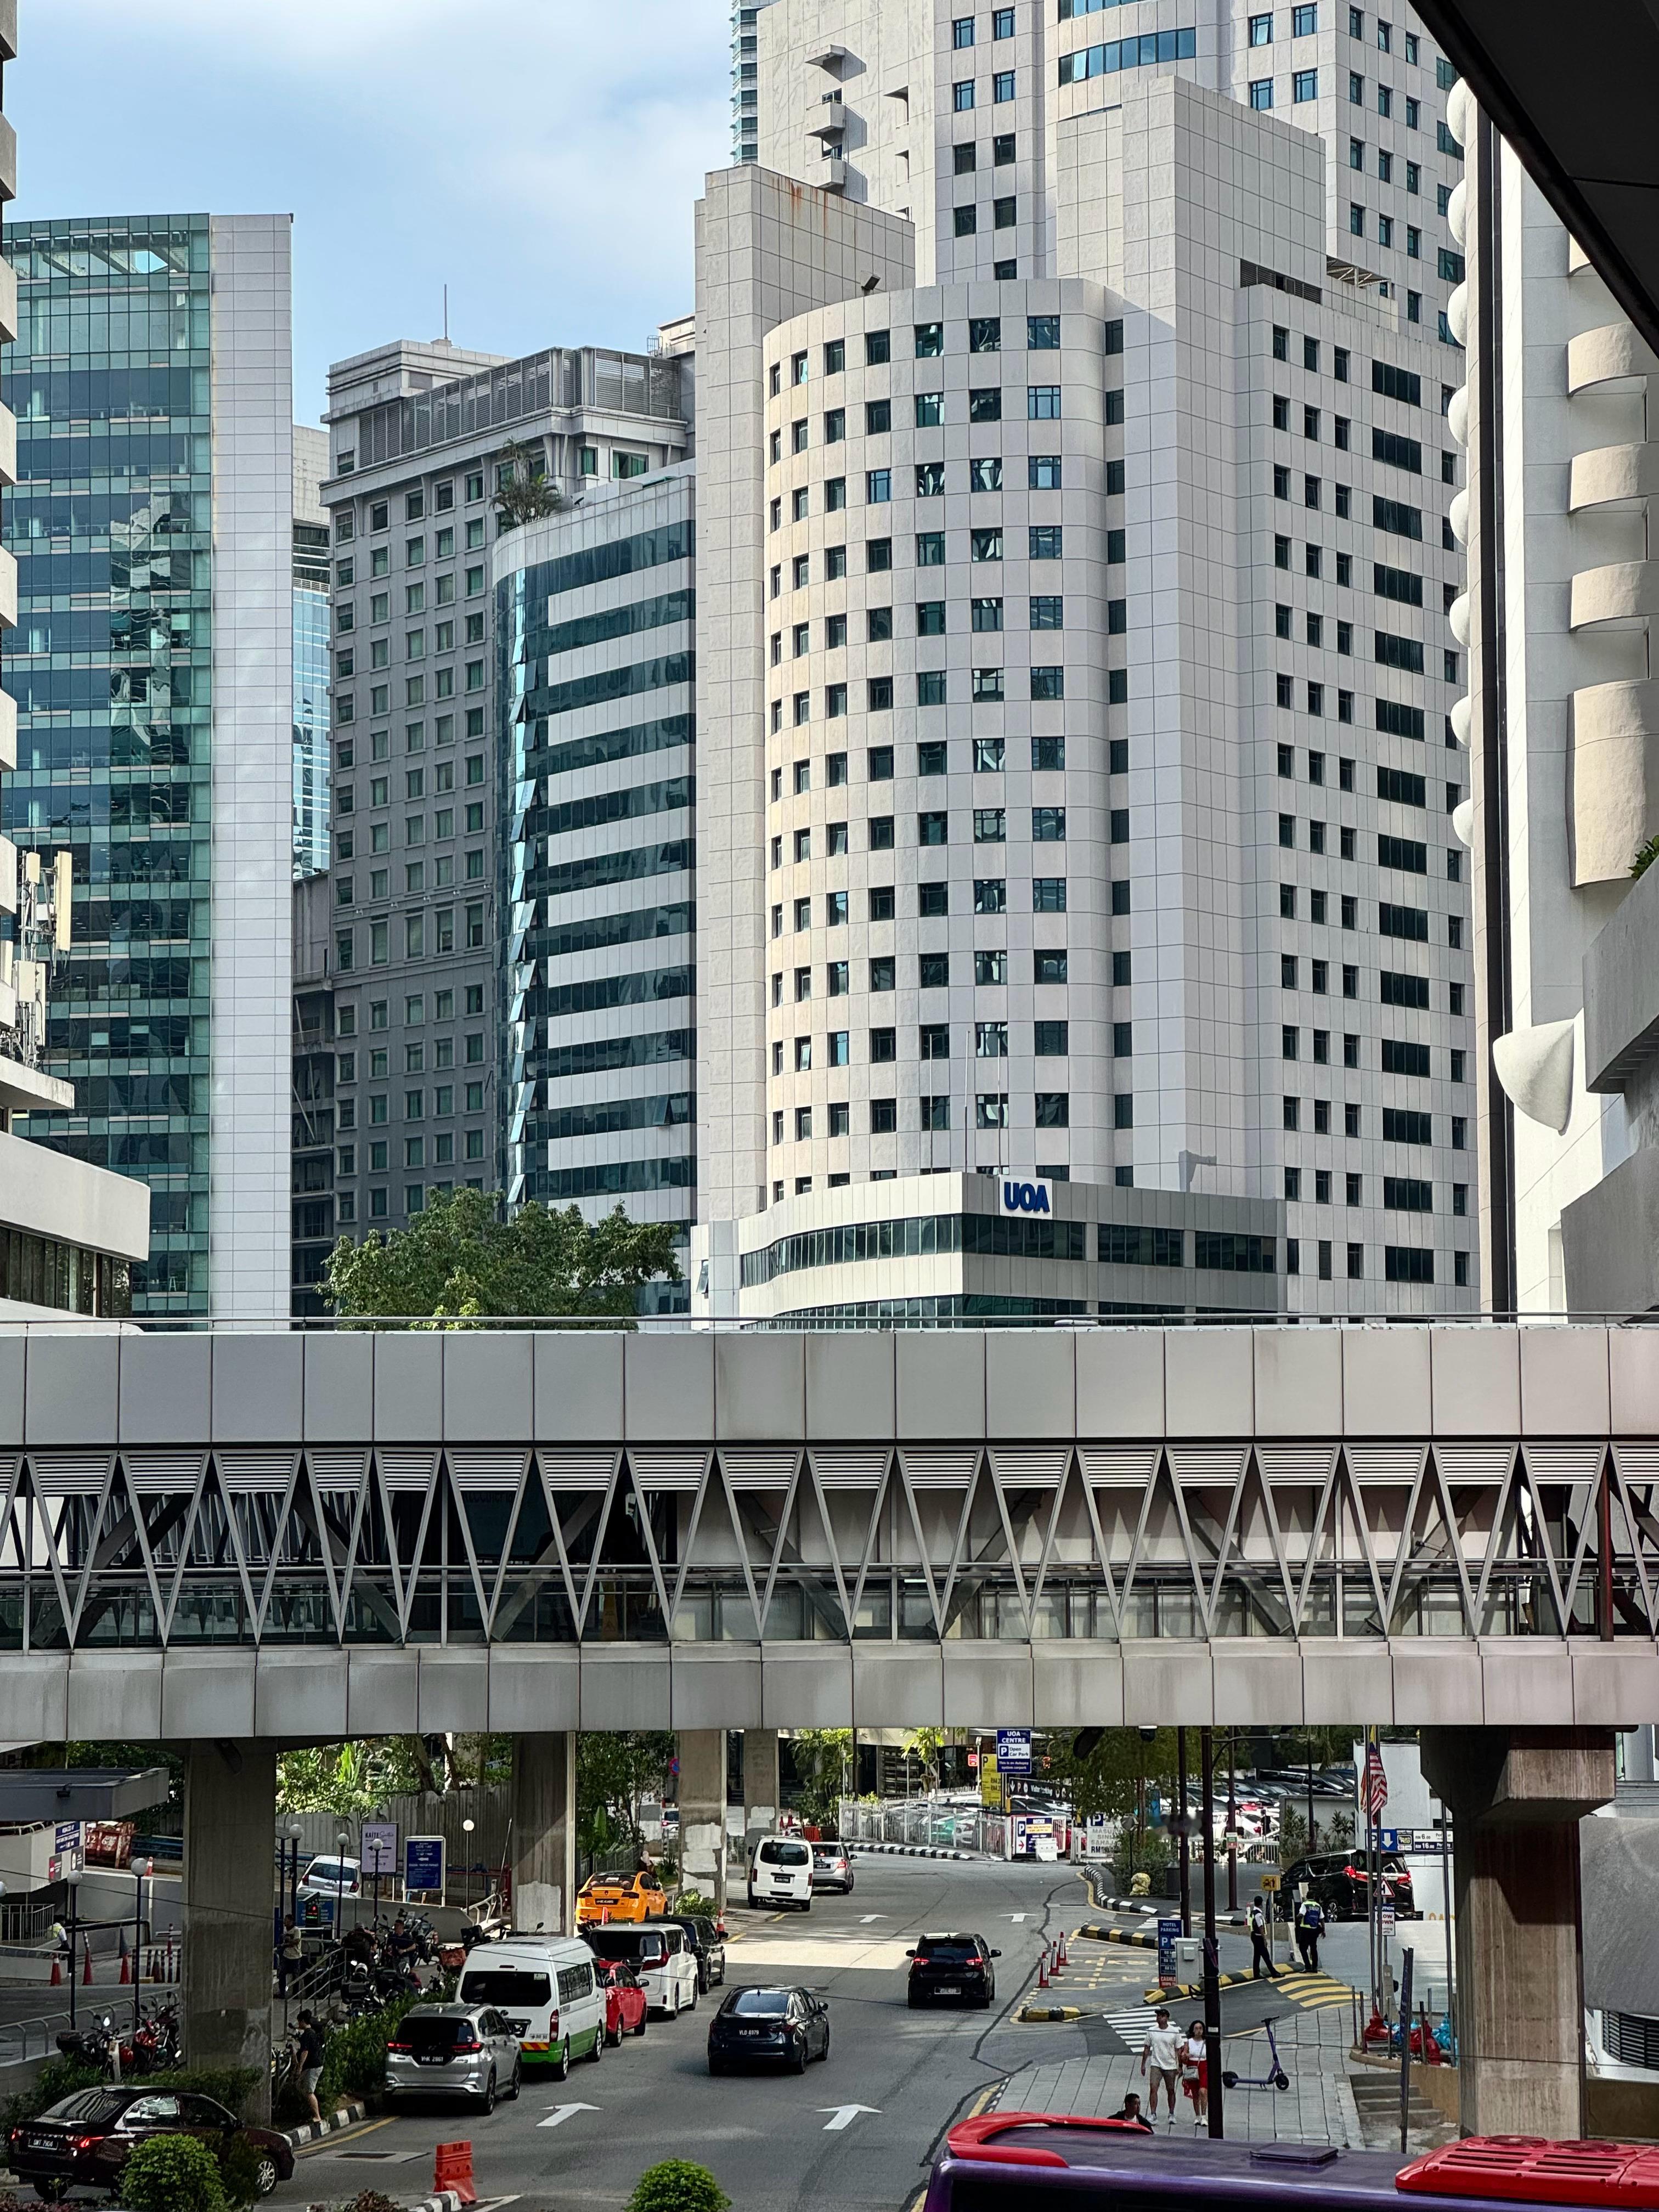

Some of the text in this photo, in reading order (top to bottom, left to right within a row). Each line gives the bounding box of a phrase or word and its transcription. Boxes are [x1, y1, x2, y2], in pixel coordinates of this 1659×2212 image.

[1004, 1182, 1050, 1212] UOA
[1001, 1747, 1007, 1756] P
[1018, 1824, 1025, 1835] P
[1161, 1937, 1168, 1946] P
